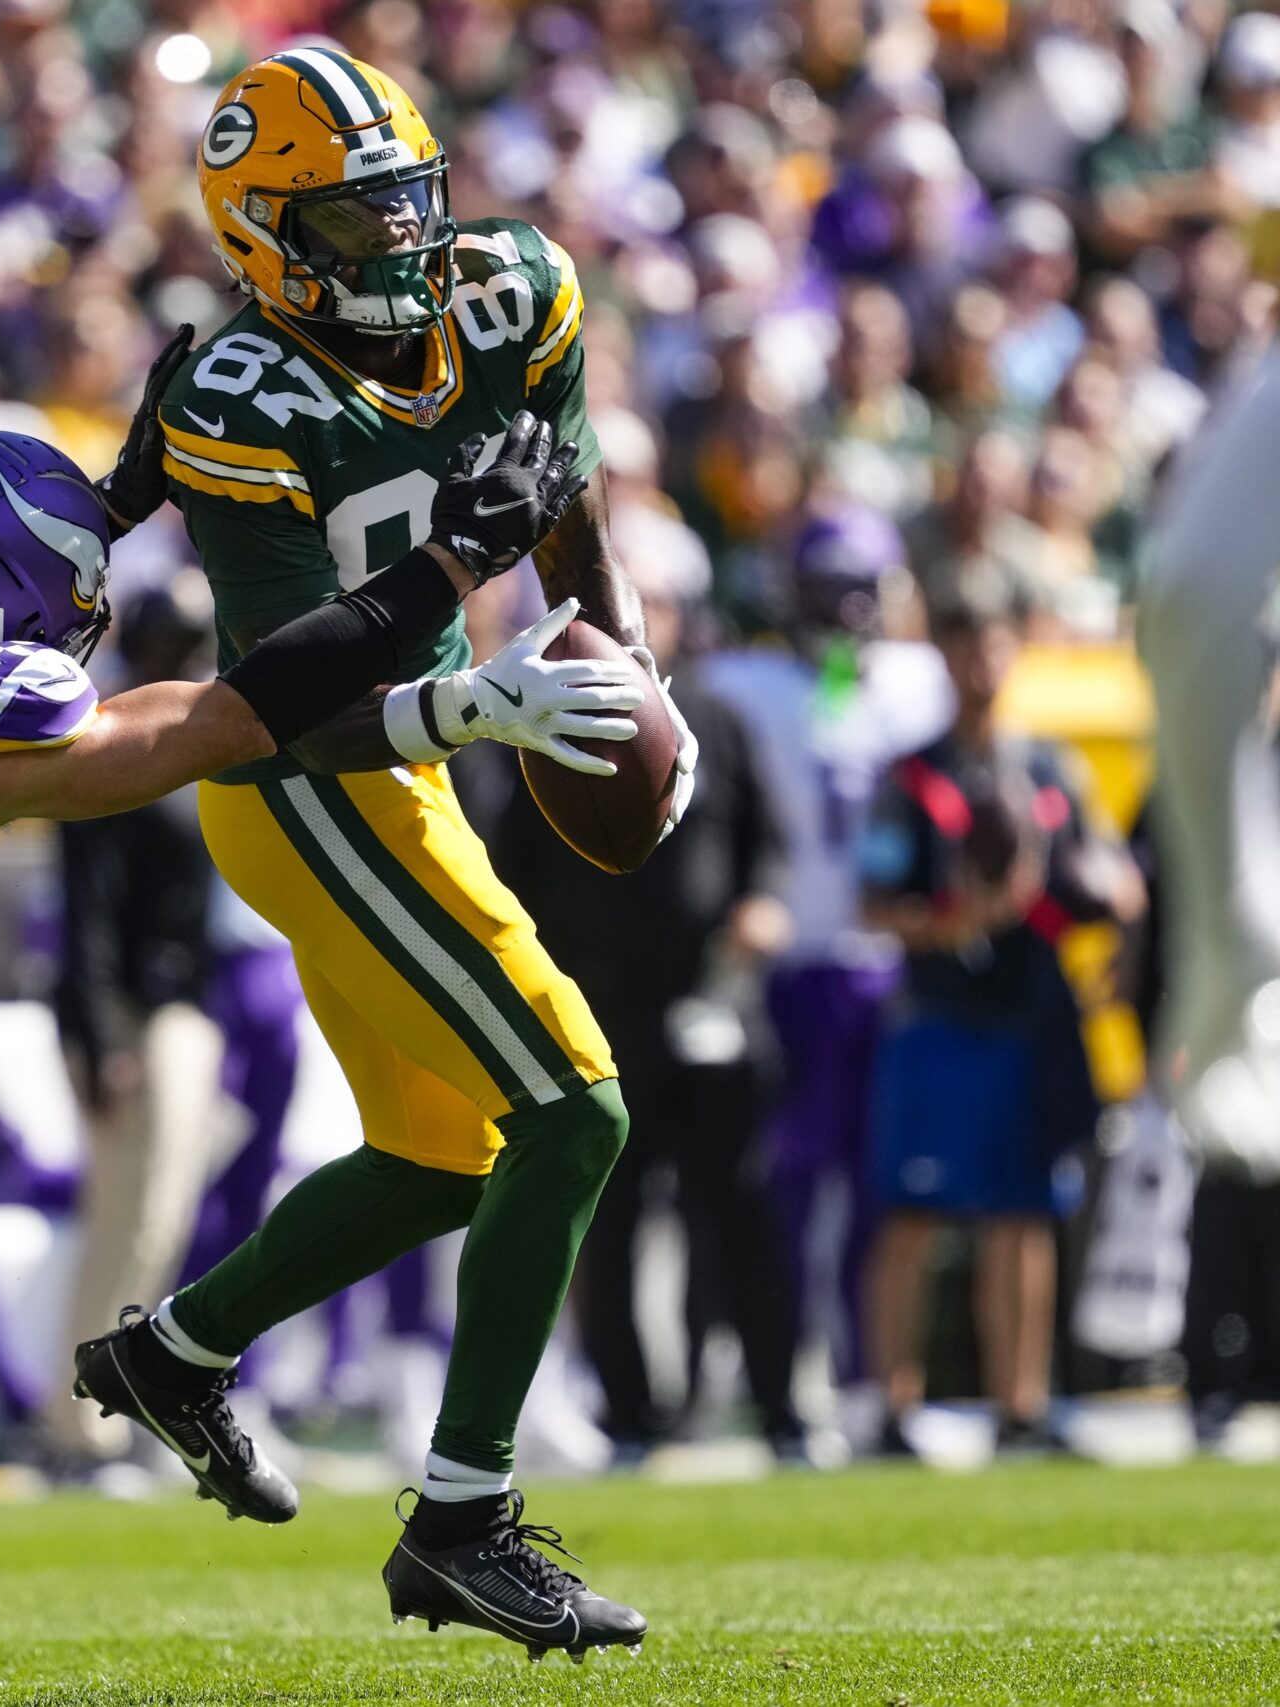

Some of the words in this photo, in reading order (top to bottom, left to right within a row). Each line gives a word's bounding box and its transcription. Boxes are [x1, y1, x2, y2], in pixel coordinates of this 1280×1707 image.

[203, 105, 253, 165] G
[360, 147, 399, 166] PACKERS
[193, 332, 345, 428] 87
[417, 407, 436, 422] NFL
